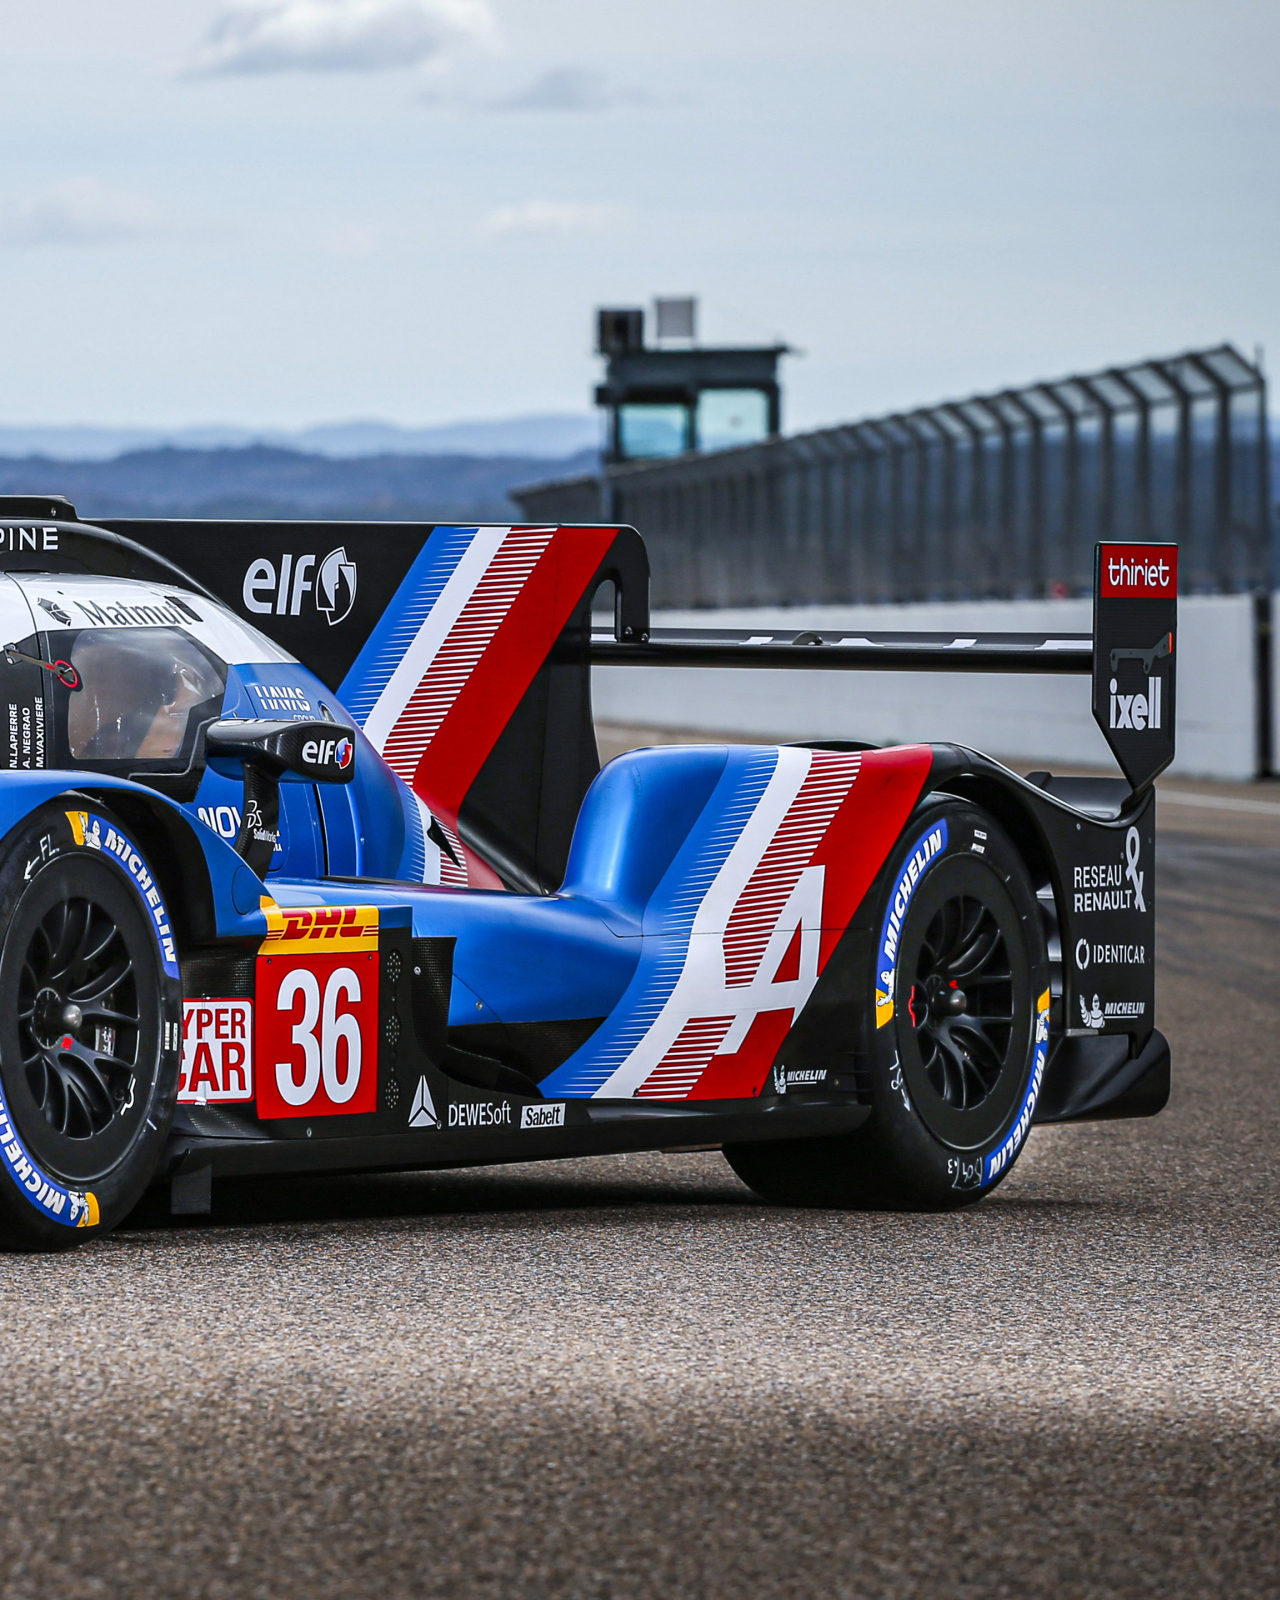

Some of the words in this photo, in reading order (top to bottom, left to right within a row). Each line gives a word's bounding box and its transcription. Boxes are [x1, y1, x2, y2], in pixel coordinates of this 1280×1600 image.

[242, 553, 316, 616] elf
[1108, 557, 1170, 587] thiriet
[72, 599, 193, 626] Matmut
[1109, 676, 1162, 731] ixell
[8, 703, 18, 768] N.LAPIERRE
[21, 707, 31, 754] NEGRAO
[34, 696, 45, 768] M.VAXIVIERE
[22, 757, 31, 769] A.
[301, 739, 336, 765] elf
[1073, 864, 1122, 889] RESEAU
[104, 828, 177, 963] MICHELIN
[884, 828, 942, 963] MICHELIN
[1073, 889, 1133, 913] RENAULT
[280, 907, 365, 940] DHL
[1093, 944, 1145, 963] IDENTICAR
[1104, 1002, 1145, 1014] MICHELIN
[182, 1008, 246, 1040] YPER
[274, 967, 362, 1106] 36
[787, 1070, 827, 1081] MICHELIN
[448, 1100, 511, 1126] DEWESoft
[525, 1106, 561, 1127] Sabelt
[988, 1050, 1046, 1179] MICHELIN
